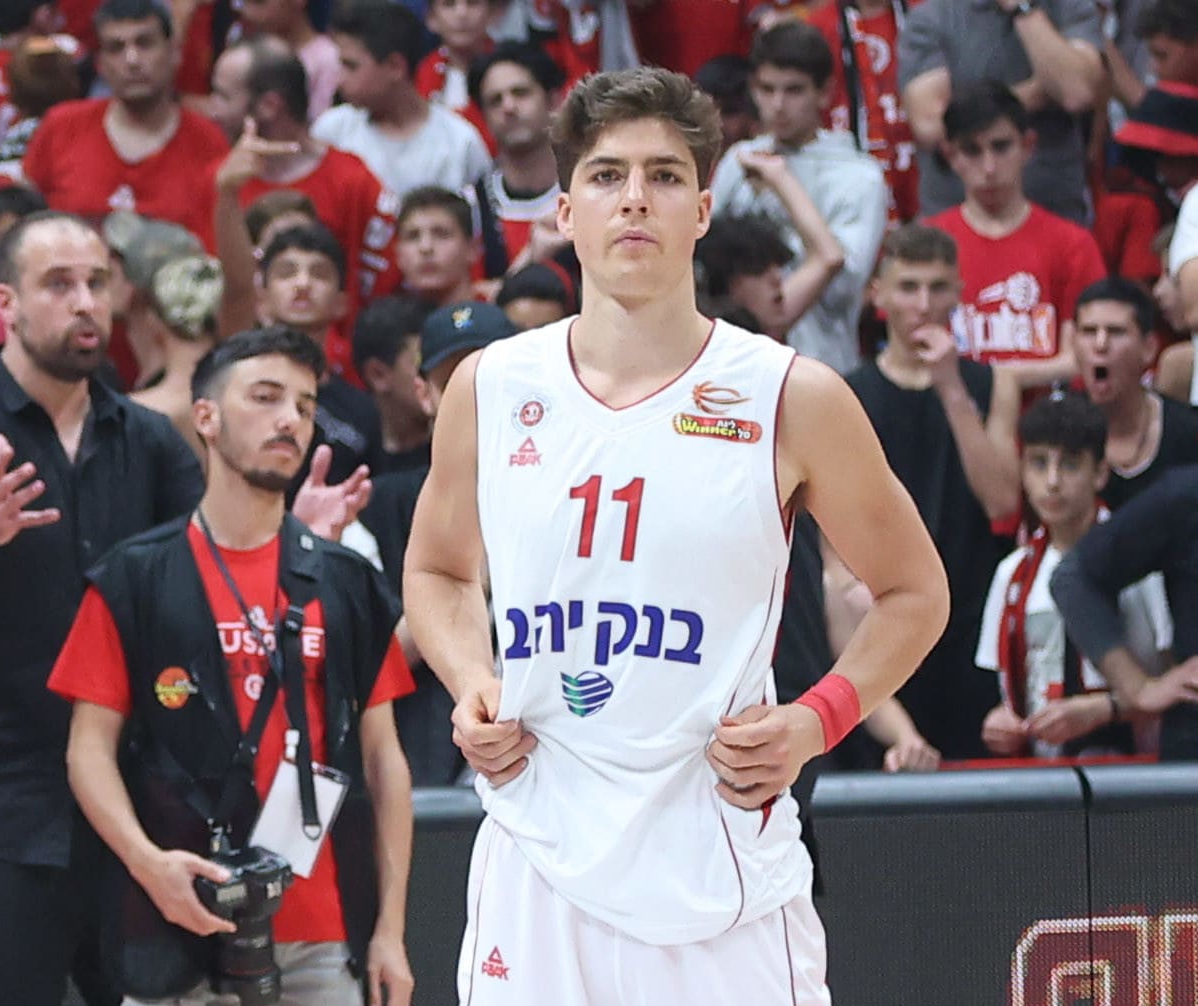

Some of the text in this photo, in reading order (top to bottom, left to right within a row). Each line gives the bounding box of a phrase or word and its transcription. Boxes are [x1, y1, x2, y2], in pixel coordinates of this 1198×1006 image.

[569, 474, 645, 562] 11
[505, 600, 704, 666] בנק יהב
